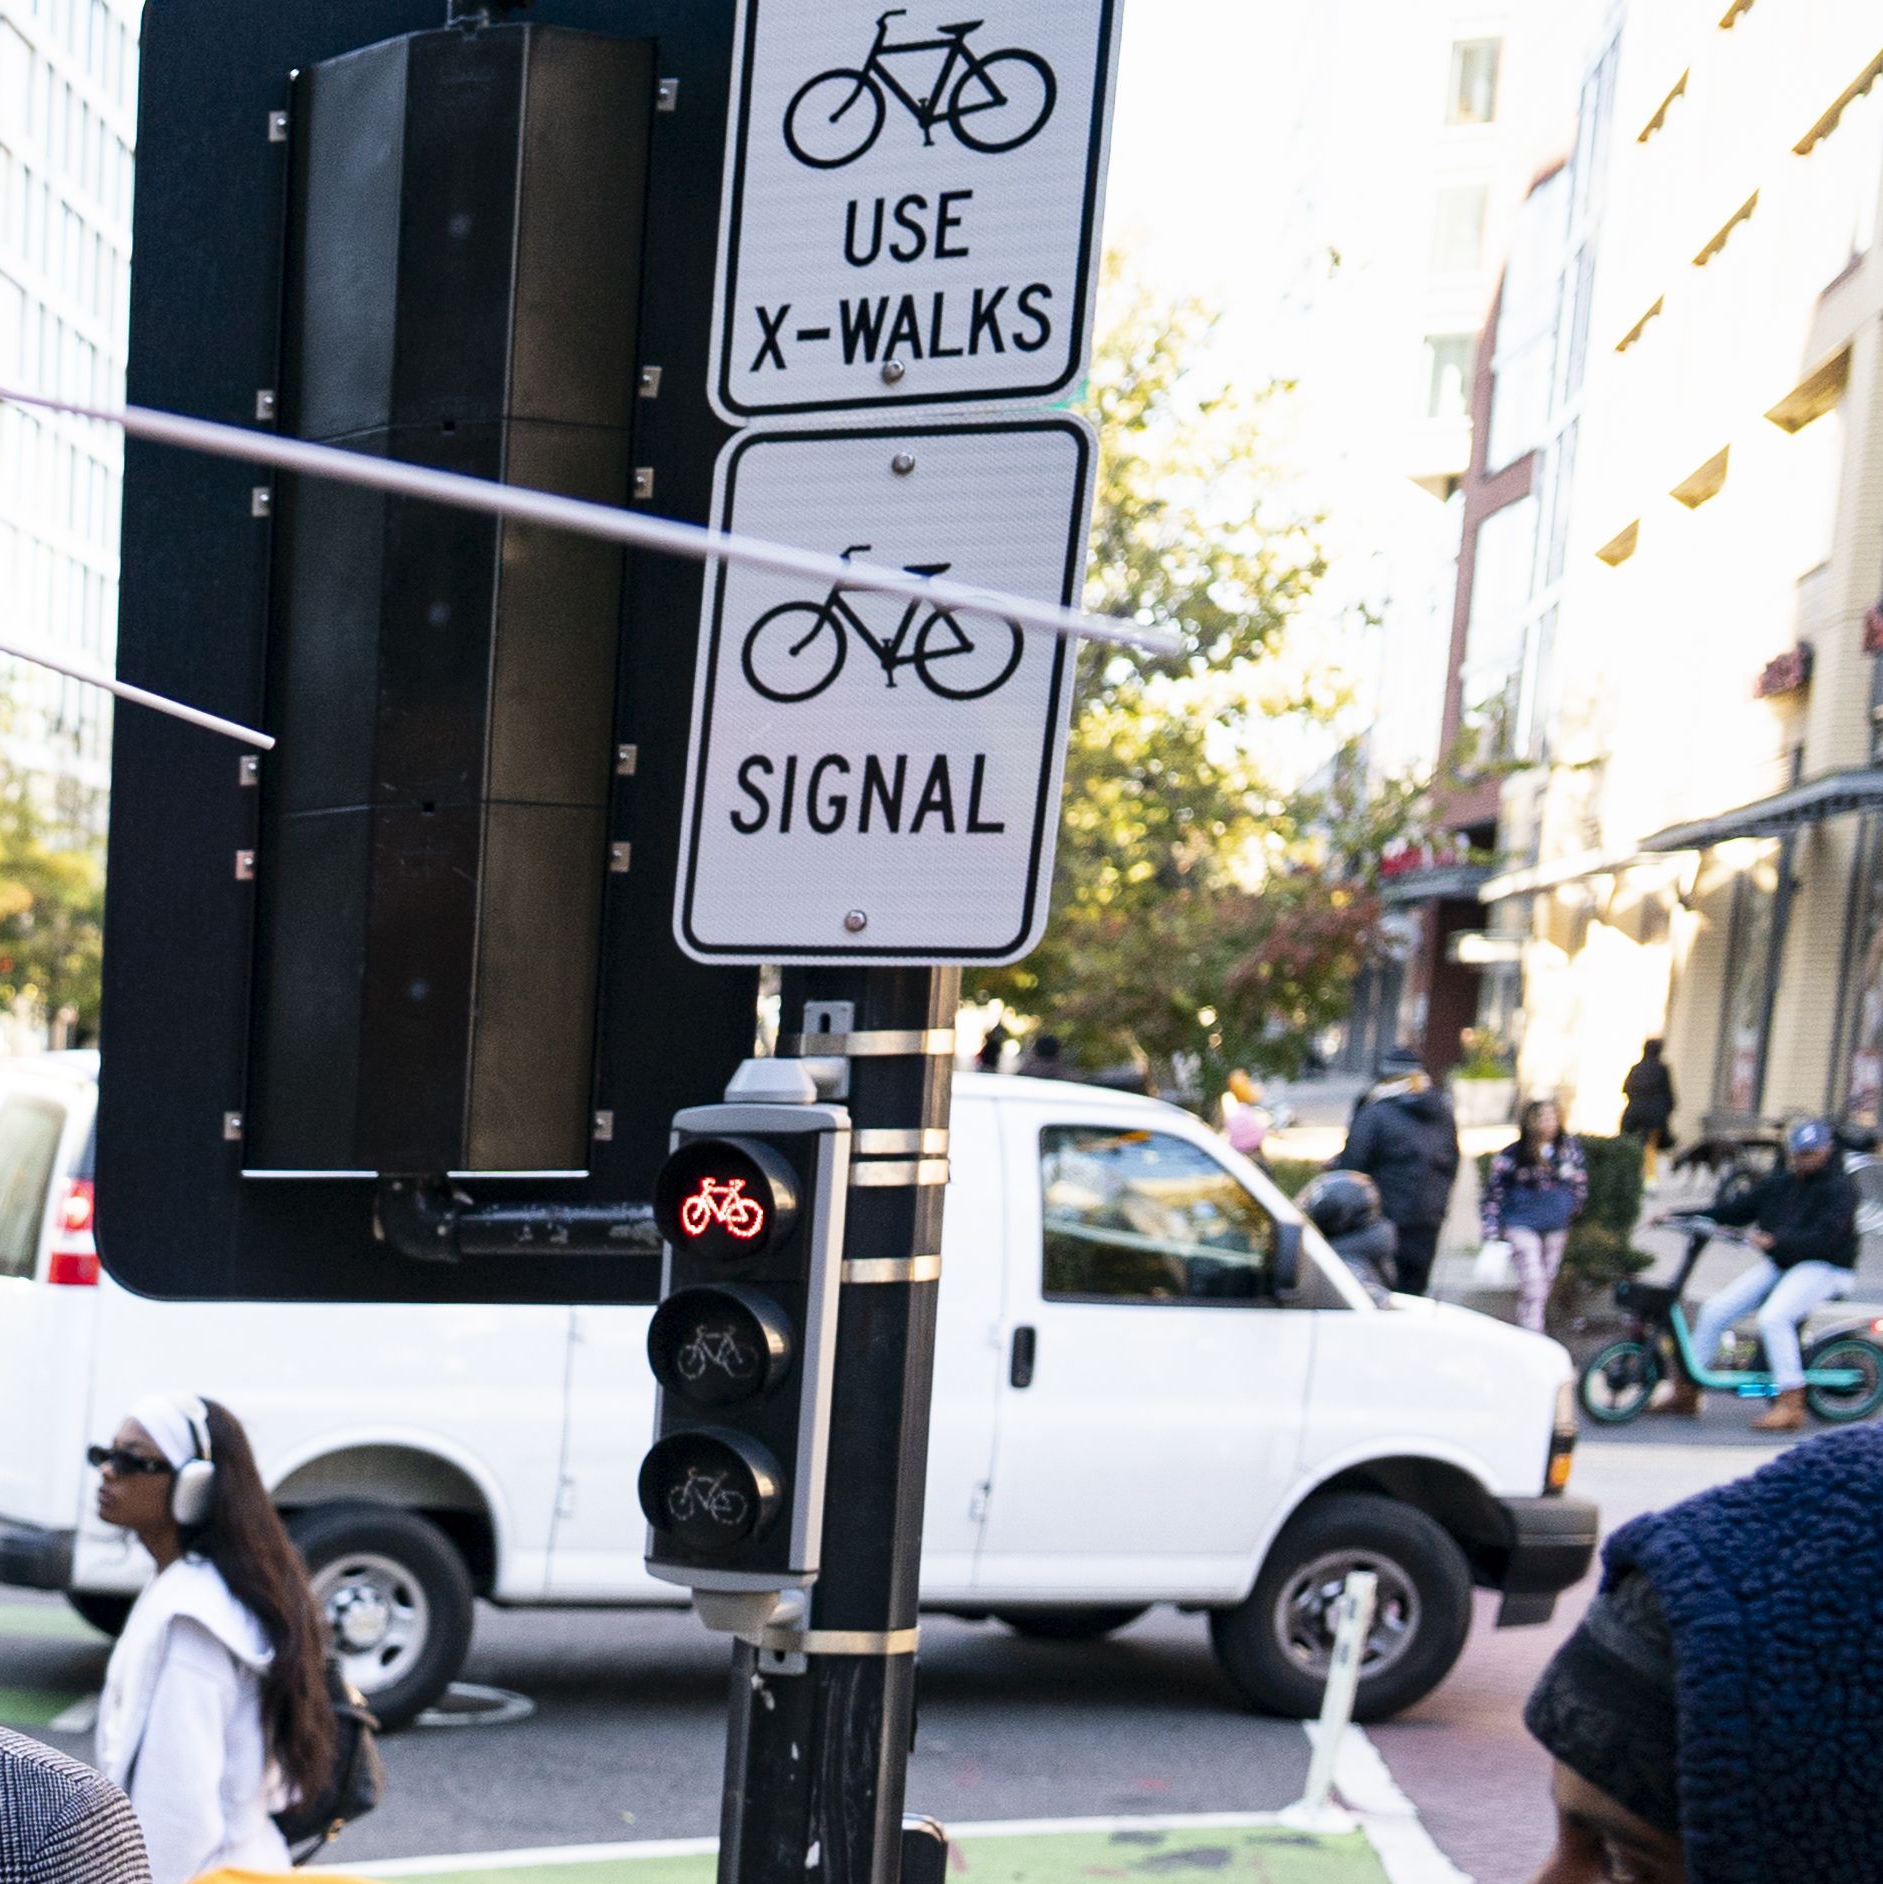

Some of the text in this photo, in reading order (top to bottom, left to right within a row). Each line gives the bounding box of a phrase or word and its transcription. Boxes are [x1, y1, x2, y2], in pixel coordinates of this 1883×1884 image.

[844, 188, 974, 268] USE
[748, 281, 1055, 374] X-WALKS
[728, 752, 1008, 835] SIGNAL
